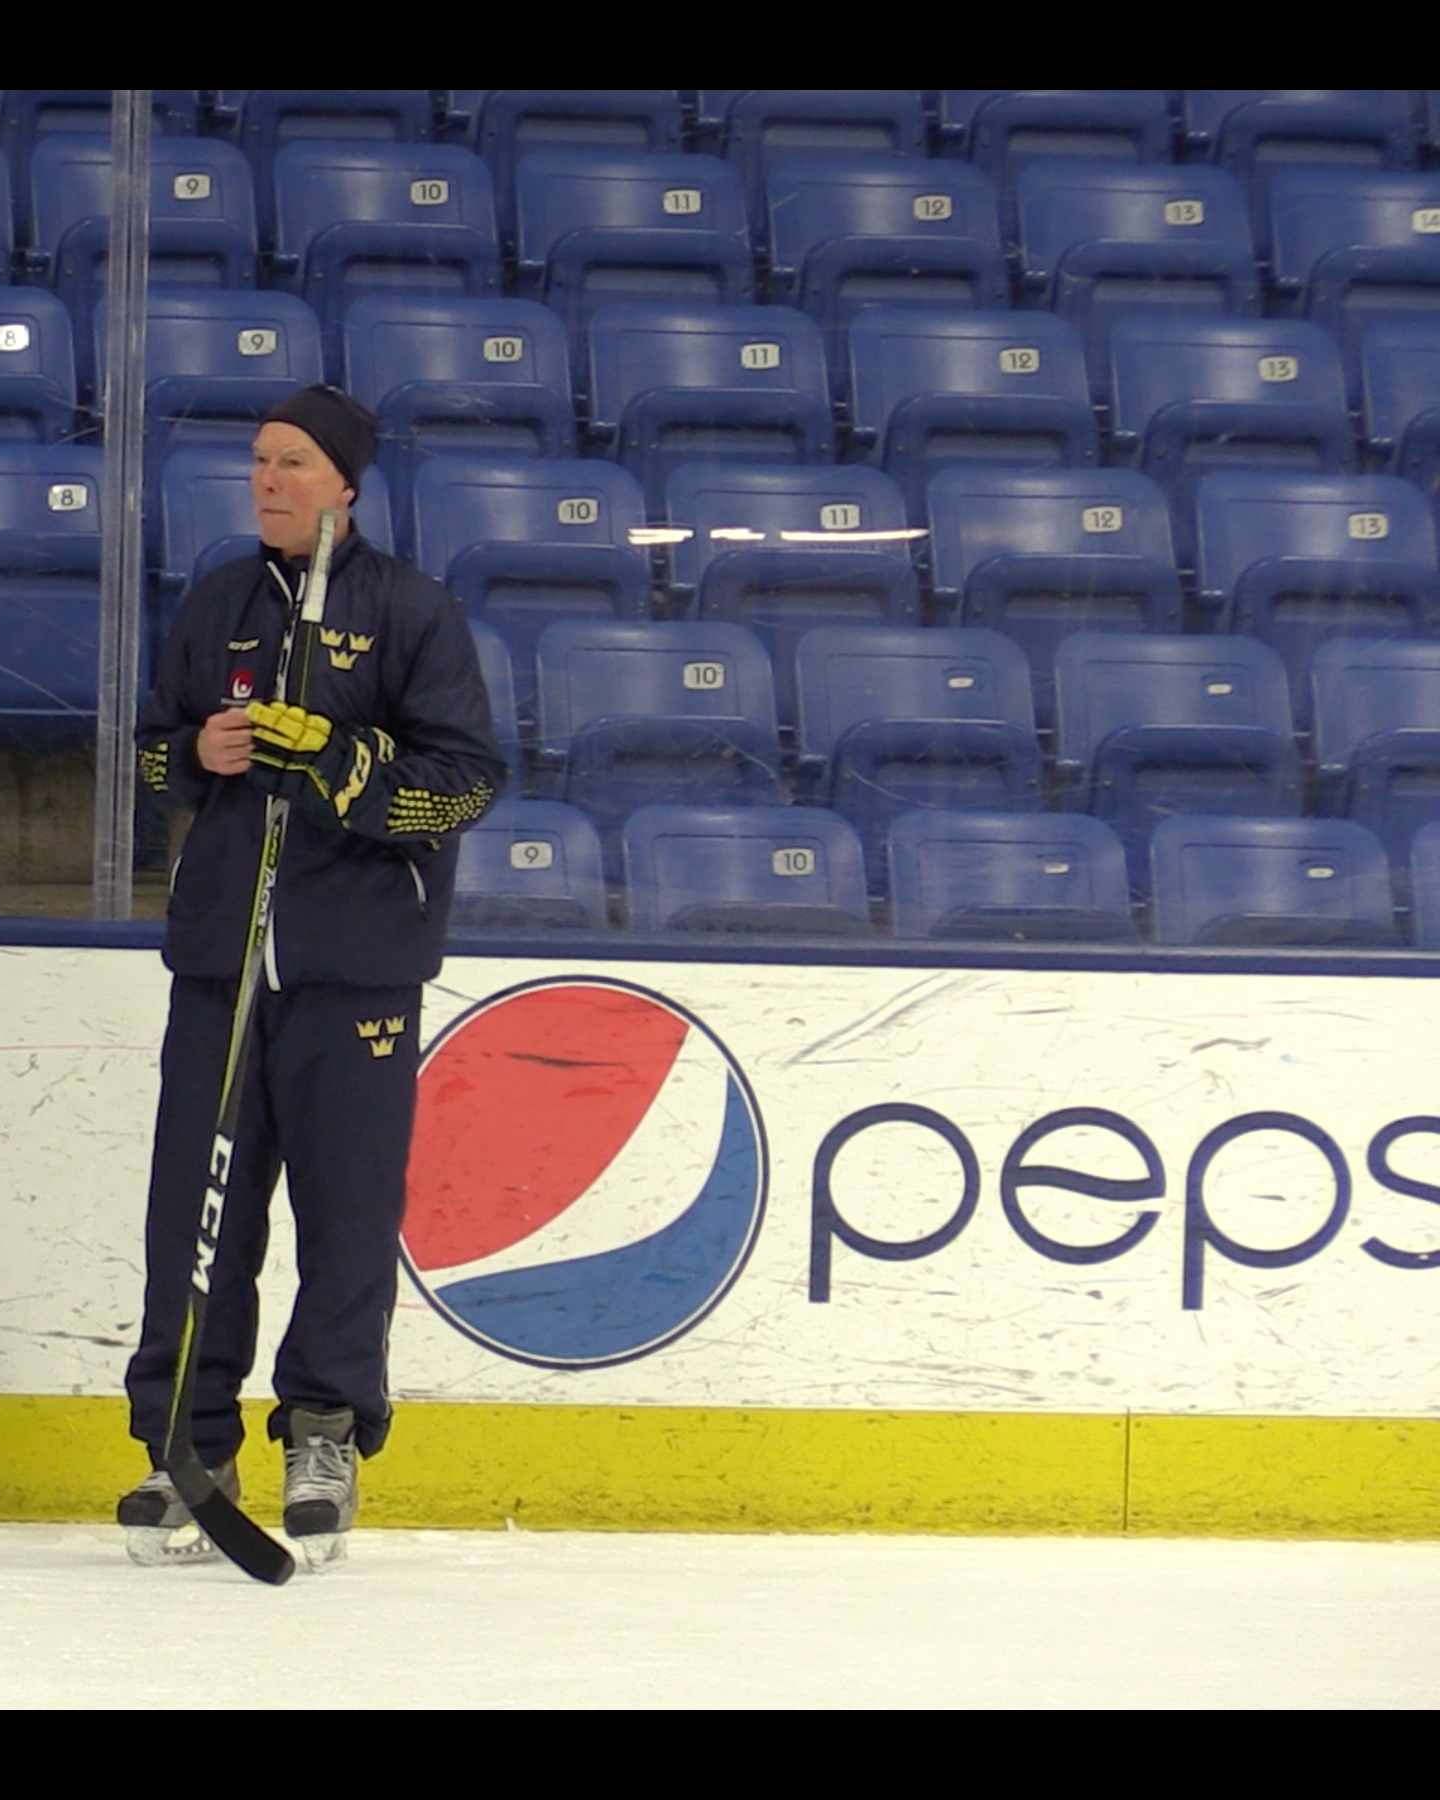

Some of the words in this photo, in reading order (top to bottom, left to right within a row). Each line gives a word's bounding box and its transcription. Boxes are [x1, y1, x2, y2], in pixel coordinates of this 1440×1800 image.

[186, 179, 199, 195] 9
[419, 183, 441, 201] 10
[671, 194, 690, 210] 11
[924, 199, 945, 216] 12
[1175, 205, 1196, 221] 13
[4, 330, 16, 347] 8
[251, 334, 264, 350] 9
[493, 341, 515, 357] 10
[751, 349, 769, 365] 11
[1010, 352, 1032, 369] 12
[1268, 360, 1289, 377] 13
[61, 489, 74, 506] 8
[566, 502, 590, 519] 10
[830, 509, 849, 525] 11
[1092, 511, 1114, 528] 12
[1360, 518, 1380, 534] 13
[693, 666, 717, 683] 10
[524, 846, 539, 864] 9
[784, 852, 808, 870] 10
[191, 1132, 234, 1295] CCM
